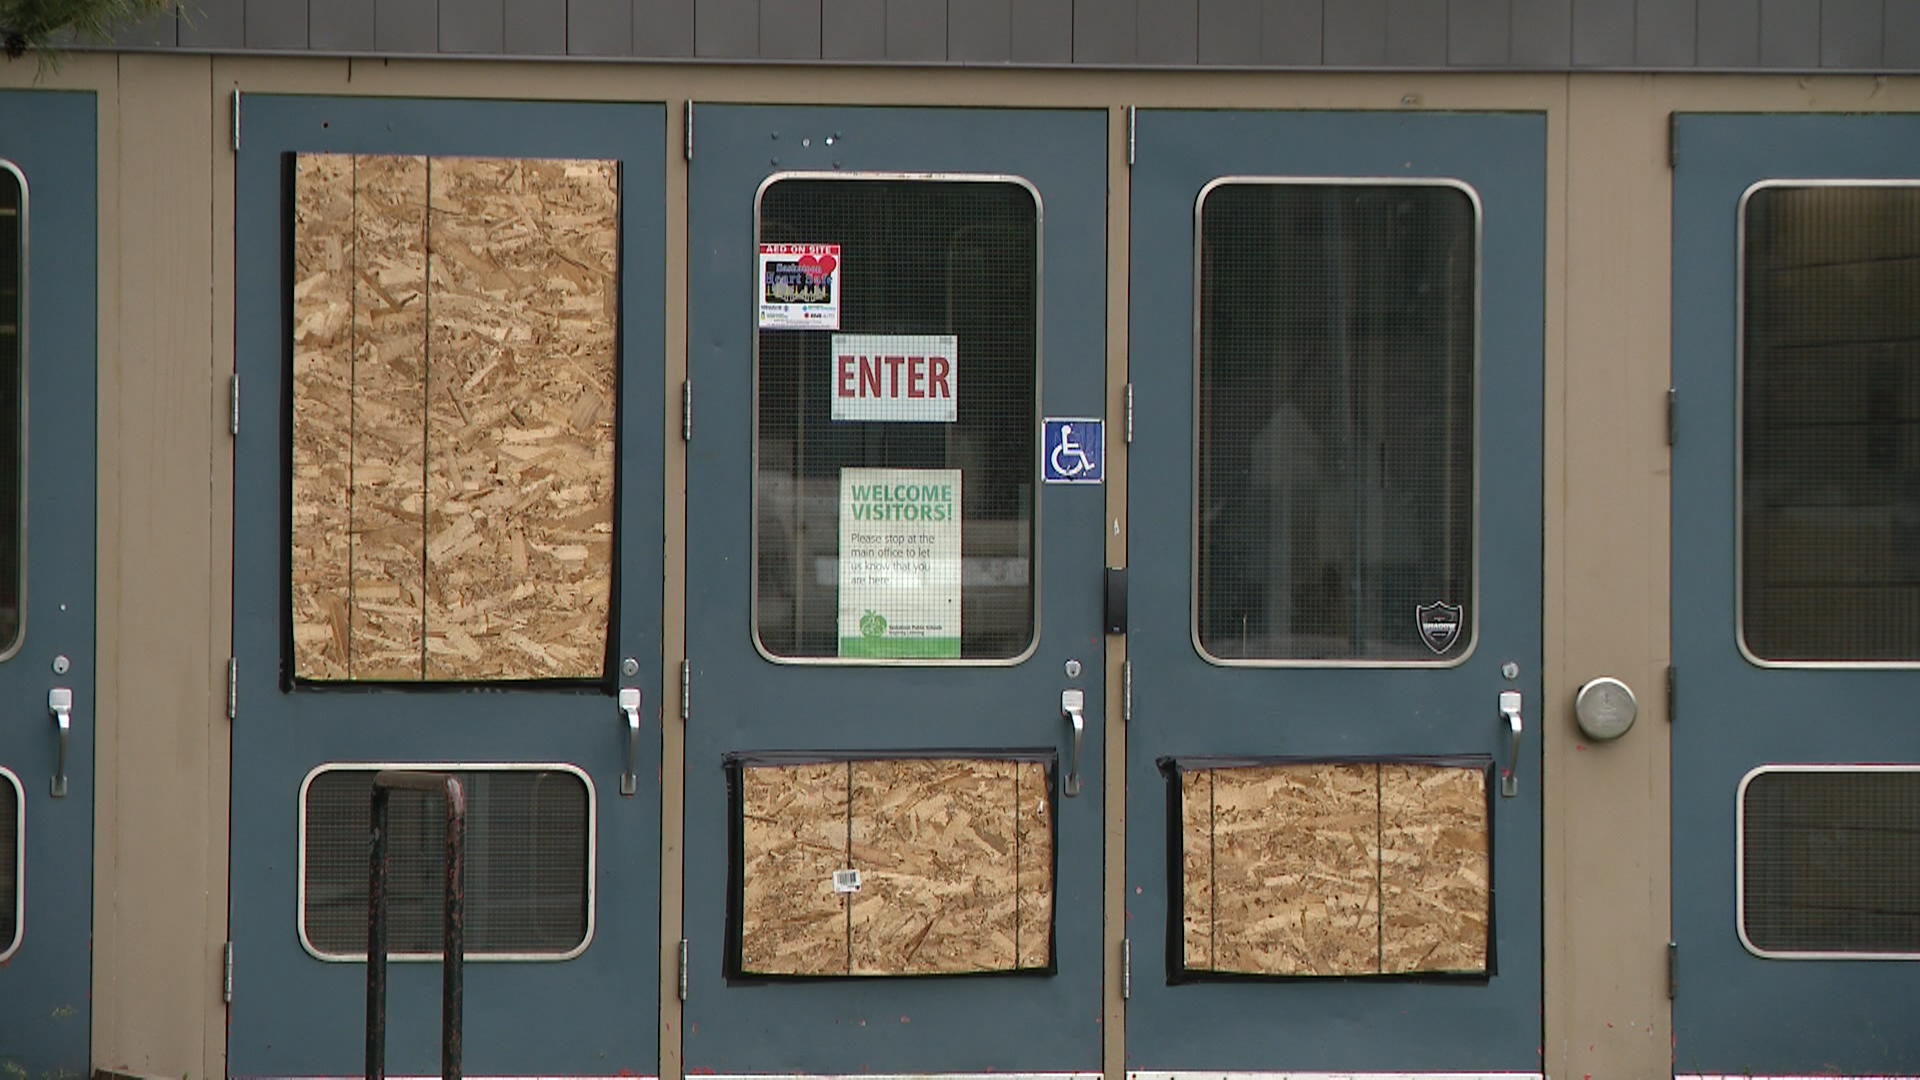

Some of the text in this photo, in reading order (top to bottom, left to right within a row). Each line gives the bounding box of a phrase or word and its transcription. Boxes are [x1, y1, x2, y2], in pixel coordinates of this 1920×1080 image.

[766, 245, 832, 255] AED ON SITE
[838, 355, 950, 398] ENTER
[851, 485, 952, 502] WELCOME
[851, 503, 952, 521] VISITORS!
[851, 532, 936, 546] Please stop at the
[851, 547, 931, 558] main office to let
[851, 560, 931, 575] us know that you
